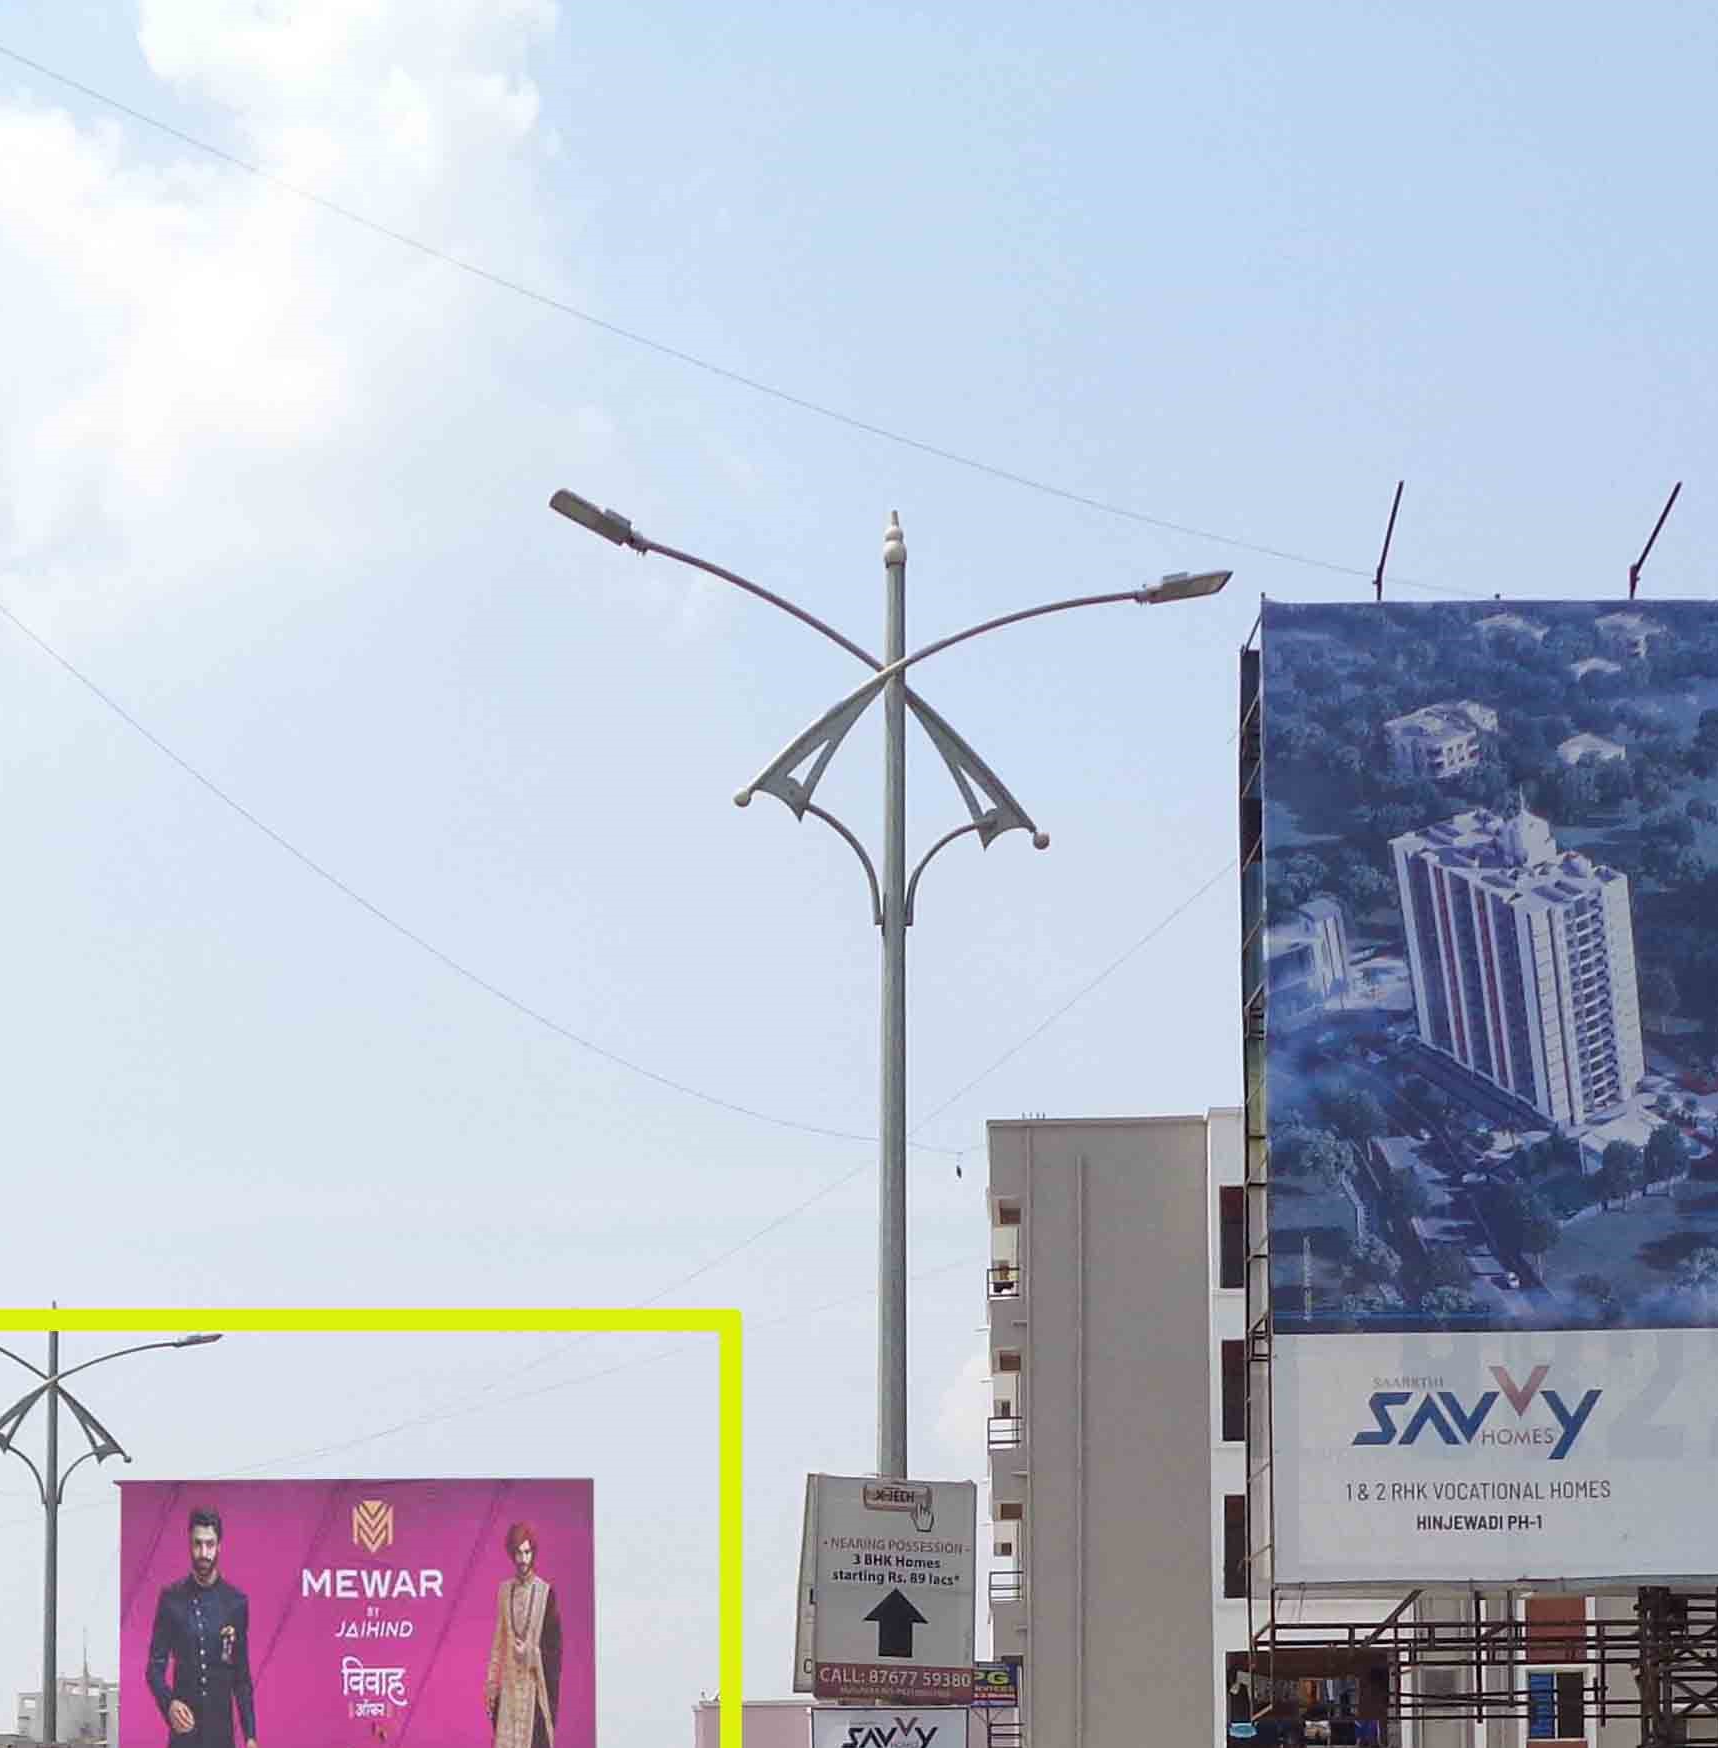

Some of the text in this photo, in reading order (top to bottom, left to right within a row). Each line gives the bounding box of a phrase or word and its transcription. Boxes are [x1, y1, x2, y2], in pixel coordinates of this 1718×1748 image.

[1352, 1365, 1603, 1460] SAVVY
[1482, 1429, 1554, 1445] HOMES
[1346, 1483, 1353, 1502] 1
[1357, 1484, 1370, 1501] &
[1376, 1484, 1386, 1501] 2
[1434, 1481, 1545, 1501] VOCATIONAL
[1549, 1480, 1611, 1500] HOMES
[1416, 1514, 1543, 1531] HINJEWADI PH-1
[888, 1540, 963, 1555] POSSESSION
[852, 1553, 941, 1569] 3 BHK Homes
[301, 1569, 444, 1599] MEWAR
[832, 1569, 884, 1584] starting
[888, 1571, 907, 1584] Rs.
[334, 1620, 415, 1638] JAIHIND
[340, 1655, 410, 1707] विवाह
[819, 1666, 866, 1683] CALL:
[922, 1671, 971, 1688] 59380
